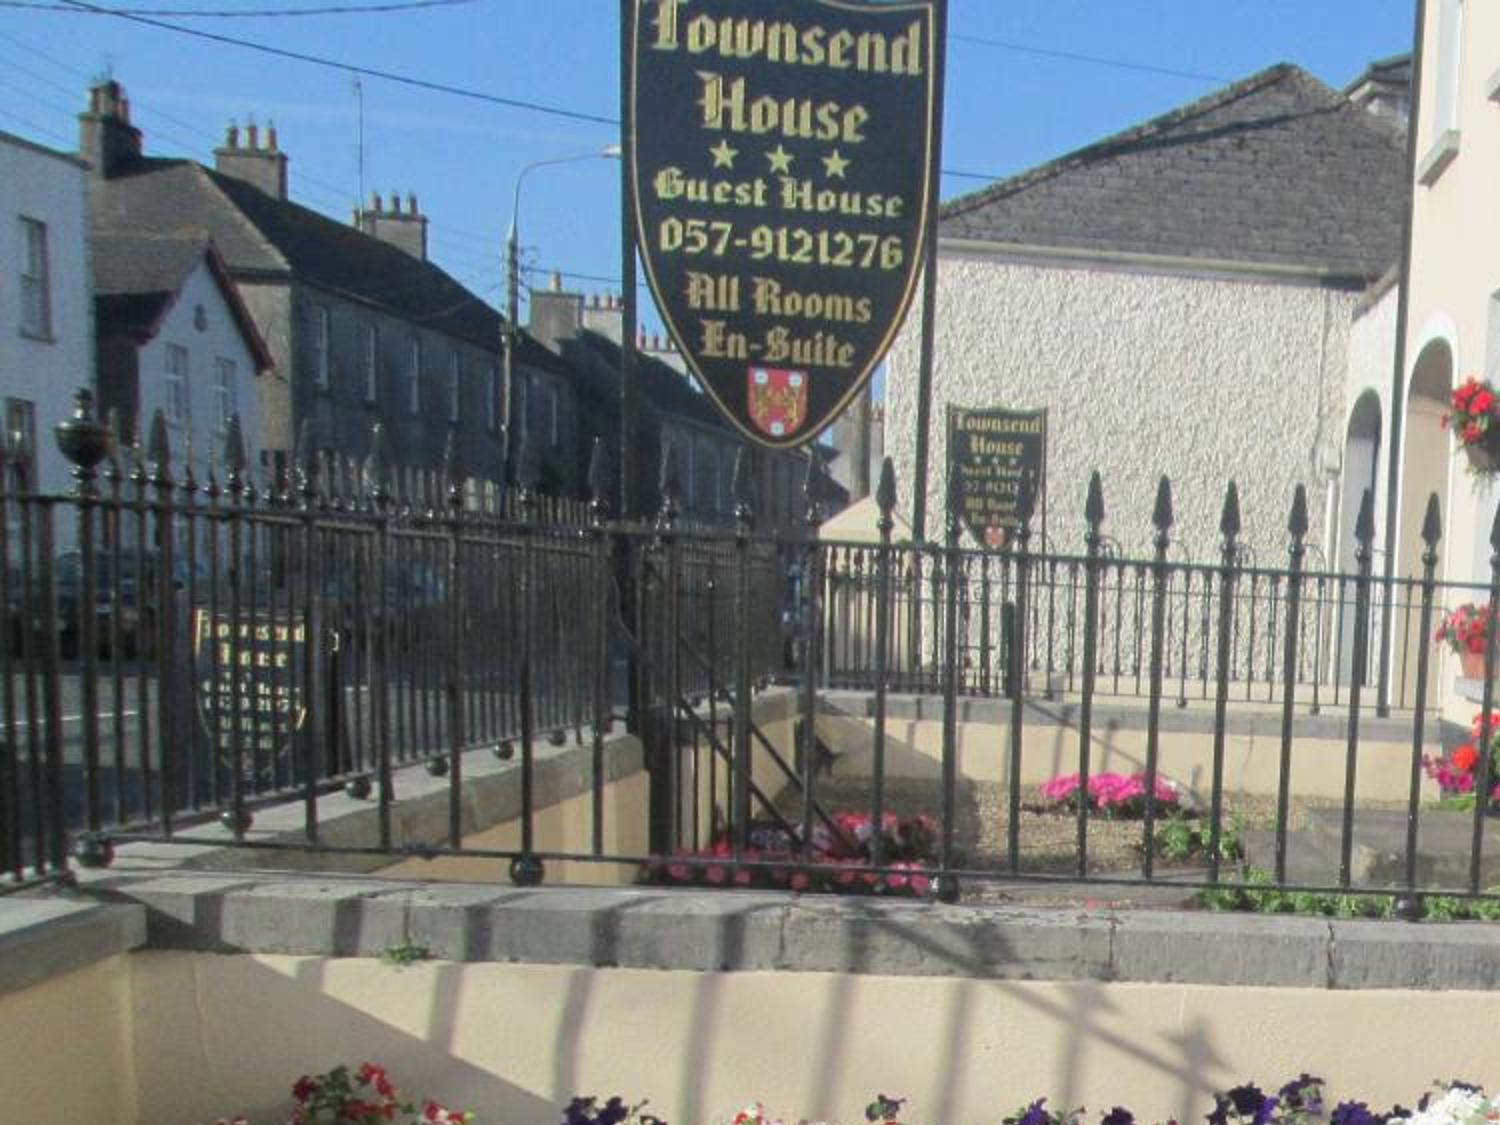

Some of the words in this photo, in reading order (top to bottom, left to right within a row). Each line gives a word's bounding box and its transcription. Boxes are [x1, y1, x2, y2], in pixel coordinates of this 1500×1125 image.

[652, 0, 923, 76] Townsend
[696, 69, 869, 143] House
[653, 166, 768, 208] Guest
[779, 175, 904, 218] House
[659, 216, 904, 270] 057-9121276
[684, 270, 742, 313] All
[751, 275, 872, 324] Rooms
[699, 318, 856, 368] En-Suite
[969, 434, 1025, 455] House
